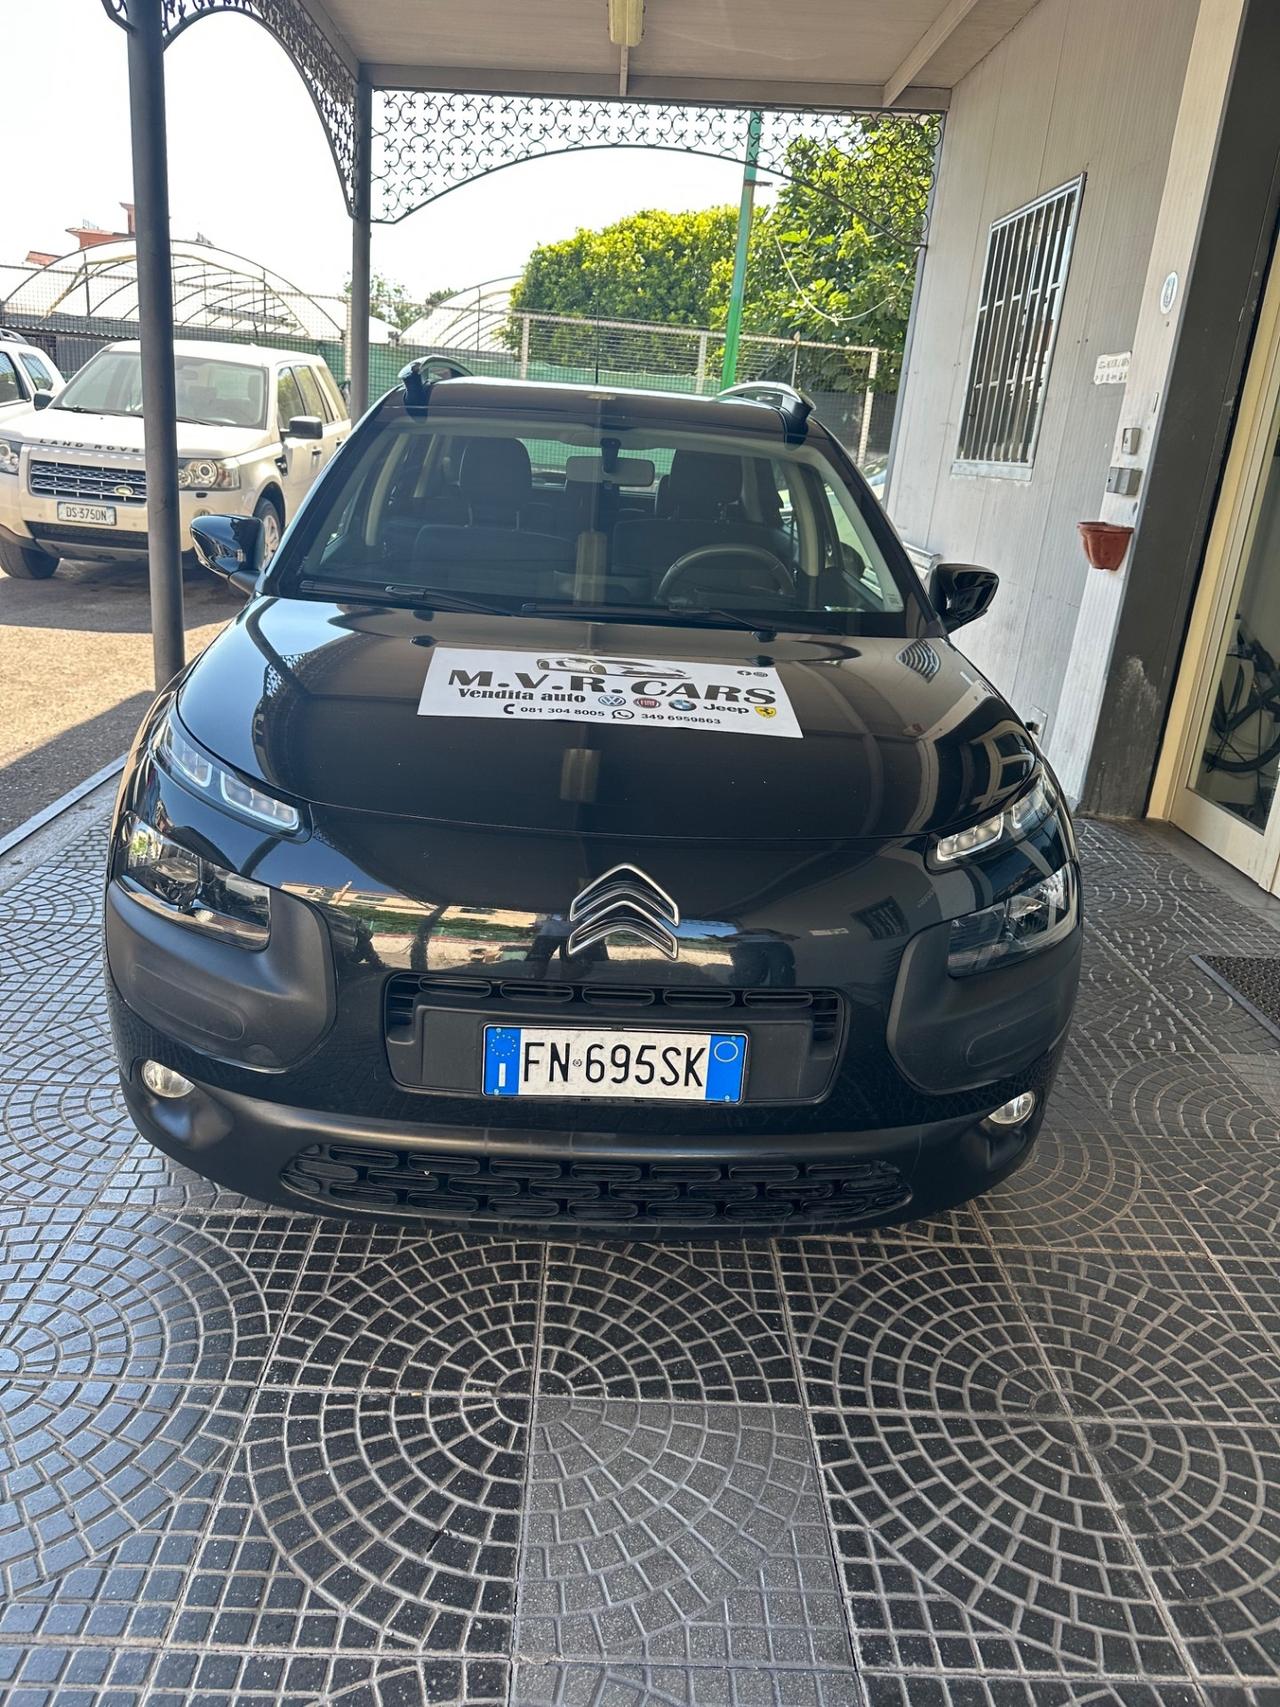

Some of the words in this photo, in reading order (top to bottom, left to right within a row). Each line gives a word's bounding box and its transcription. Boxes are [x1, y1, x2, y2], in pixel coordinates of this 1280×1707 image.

[40, 438, 84, 448] LAND
[94, 444, 140, 453] ROVE
[458, 688, 534, 700] Vendita
[541, 692, 586, 703] auto
[704, 704, 749, 714] Jeep
